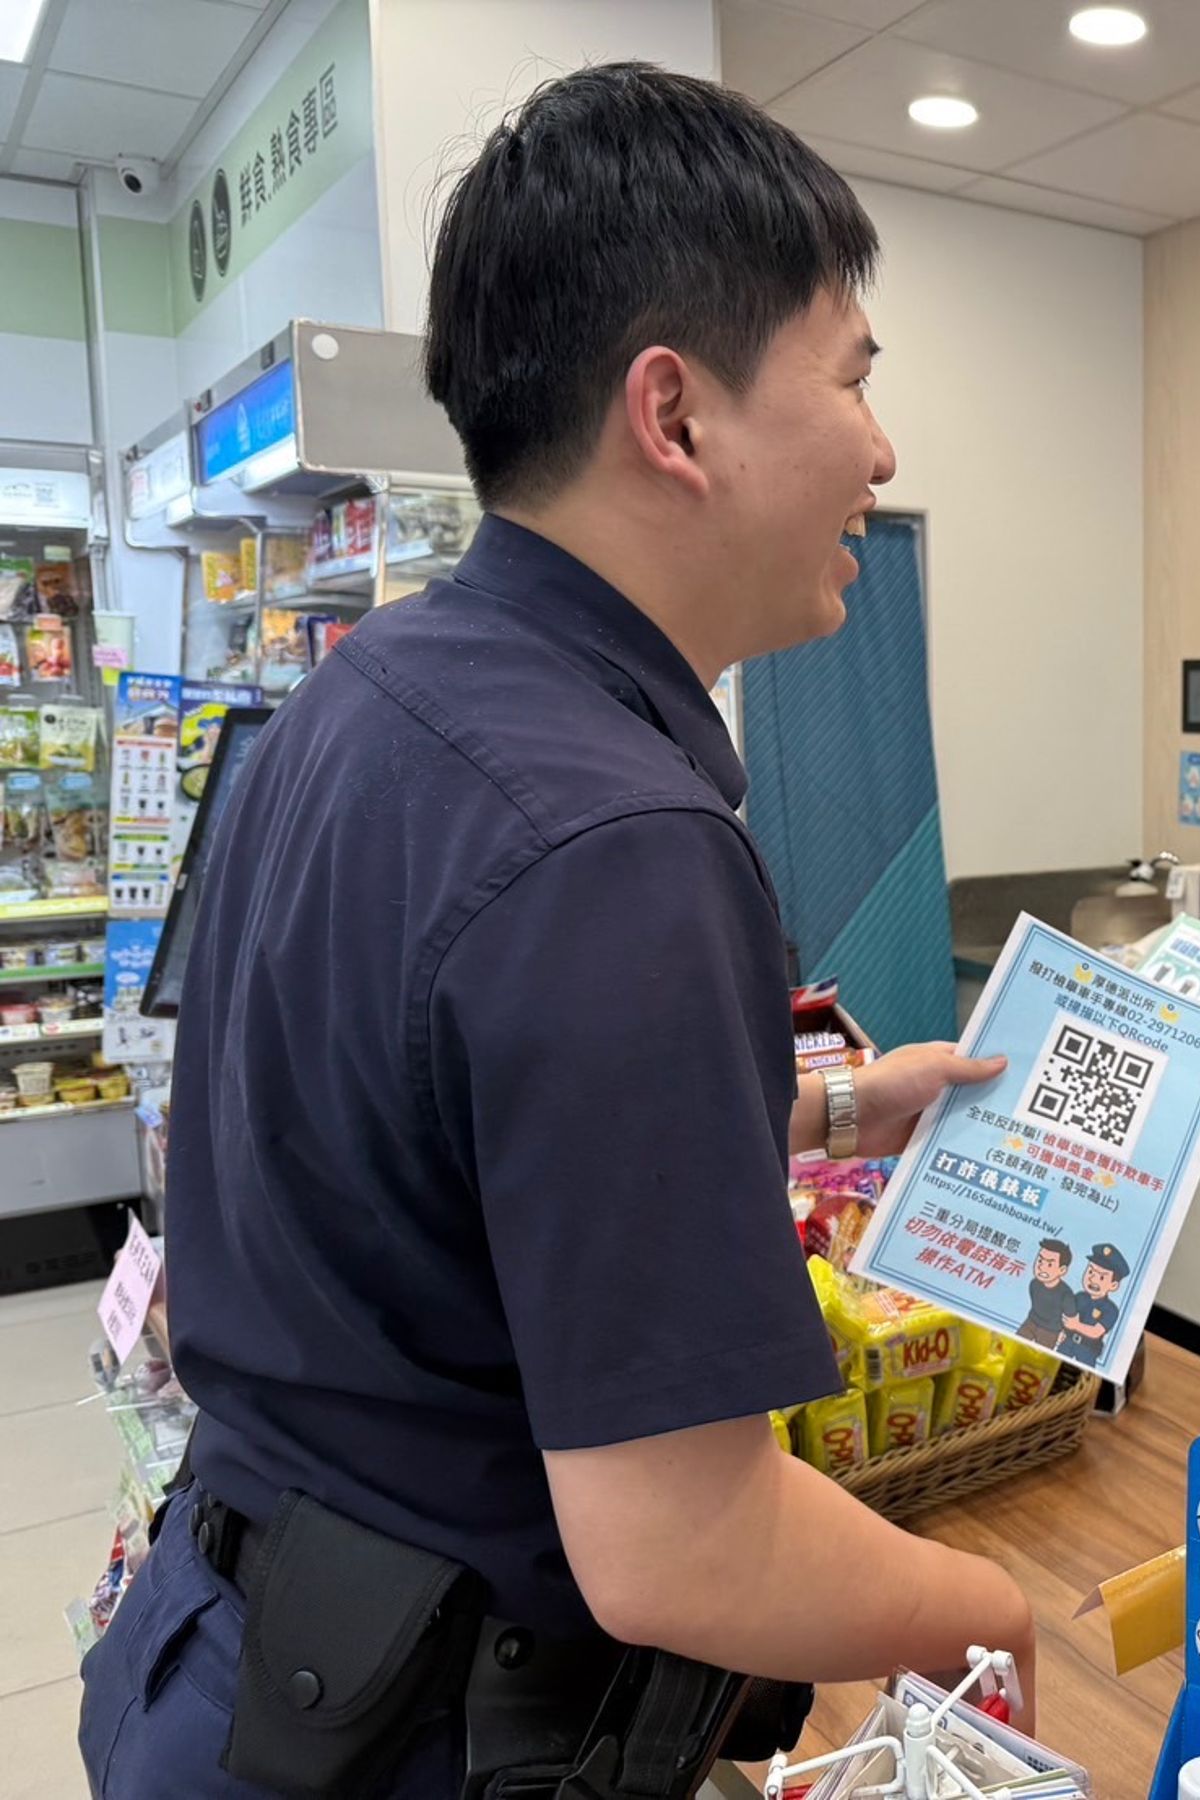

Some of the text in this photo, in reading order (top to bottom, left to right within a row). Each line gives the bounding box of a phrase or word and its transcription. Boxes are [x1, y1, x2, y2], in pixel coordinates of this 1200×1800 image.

[1092, 973, 1157, 1012] 厚德派出所
[795, 1032, 845, 1052] NICKERS
[922, 1172, 1064, 1237] https://165dashboard.tw/
[904, 1216, 1027, 1278] 切勿依電話指示
[919, 1201, 1022, 1254] 三重分局提醒您
[915, 1246, 997, 1290] 操作ATM
[902, 1327, 950, 1367] Kid-O
